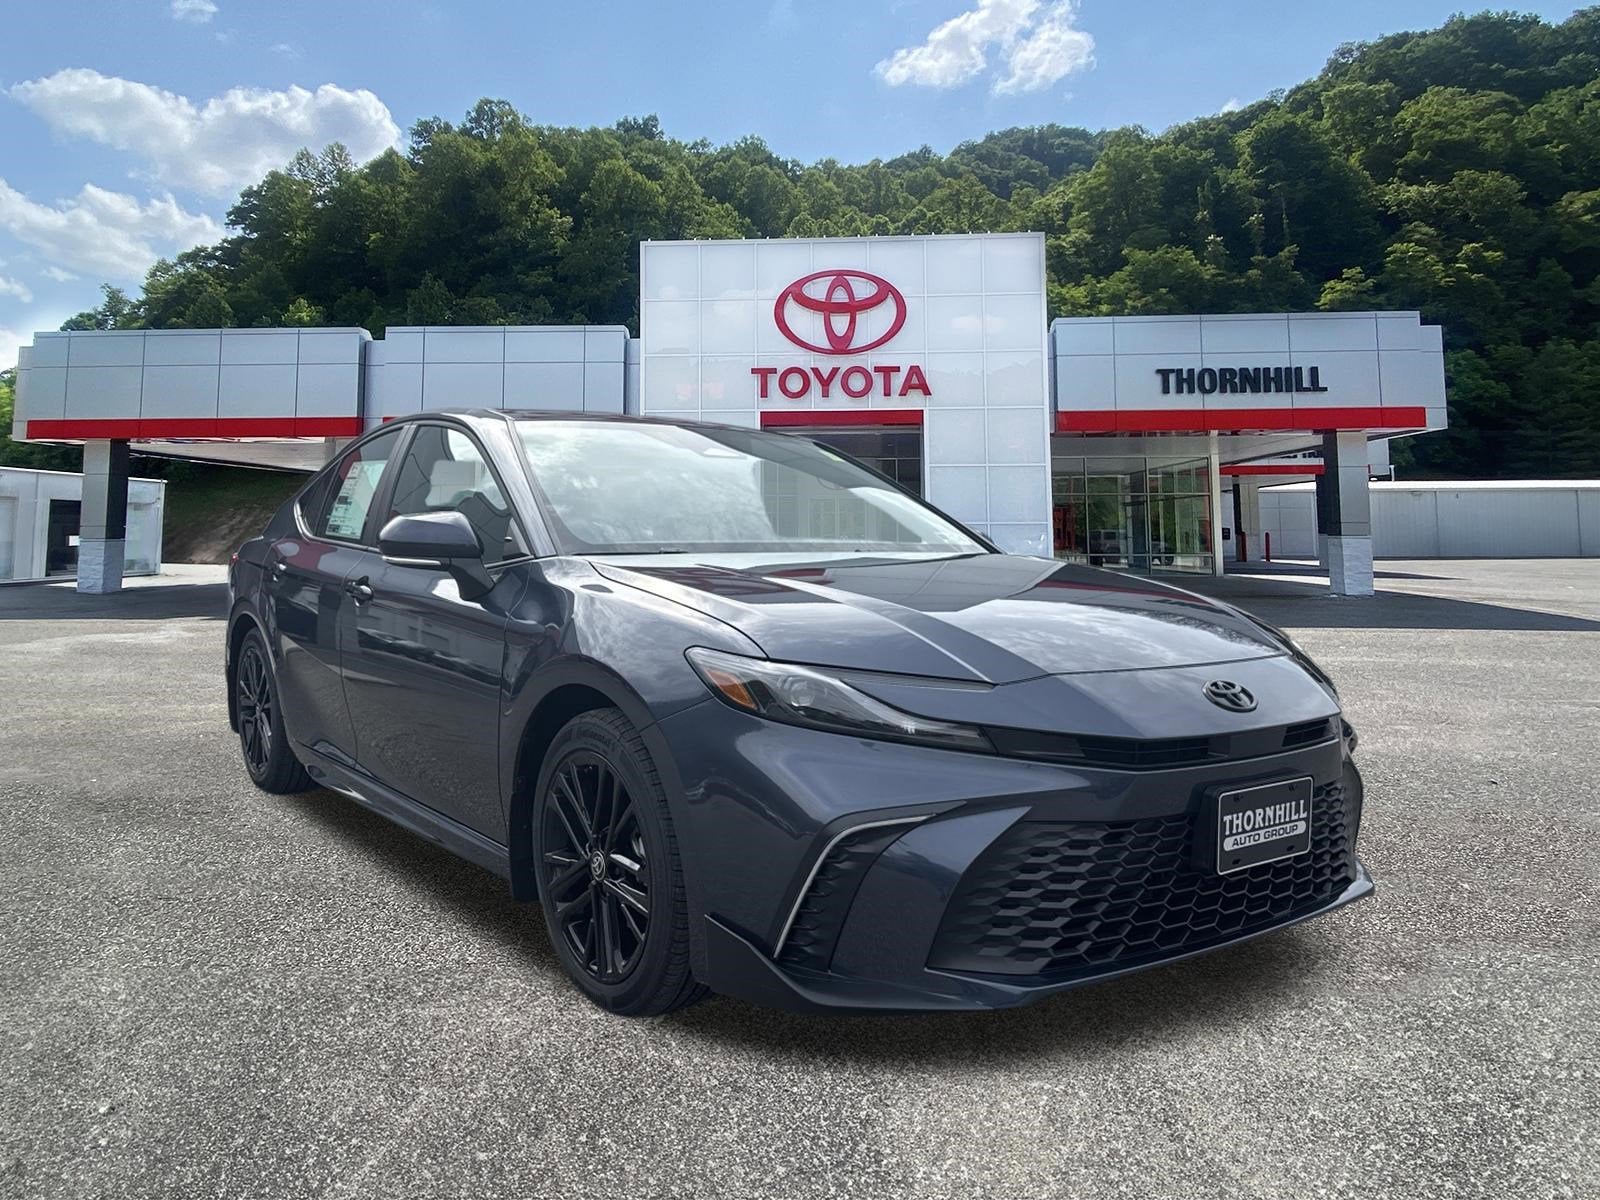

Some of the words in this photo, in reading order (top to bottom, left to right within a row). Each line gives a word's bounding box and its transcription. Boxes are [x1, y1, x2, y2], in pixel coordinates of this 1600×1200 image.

[750, 365, 932, 399] TOYOTA
[1155, 366, 1328, 394] THORNHILL
[1223, 799, 1308, 836] THORNHILL
[1232, 832, 1261, 848] AUTO
[1263, 823, 1299, 840] GROUP
